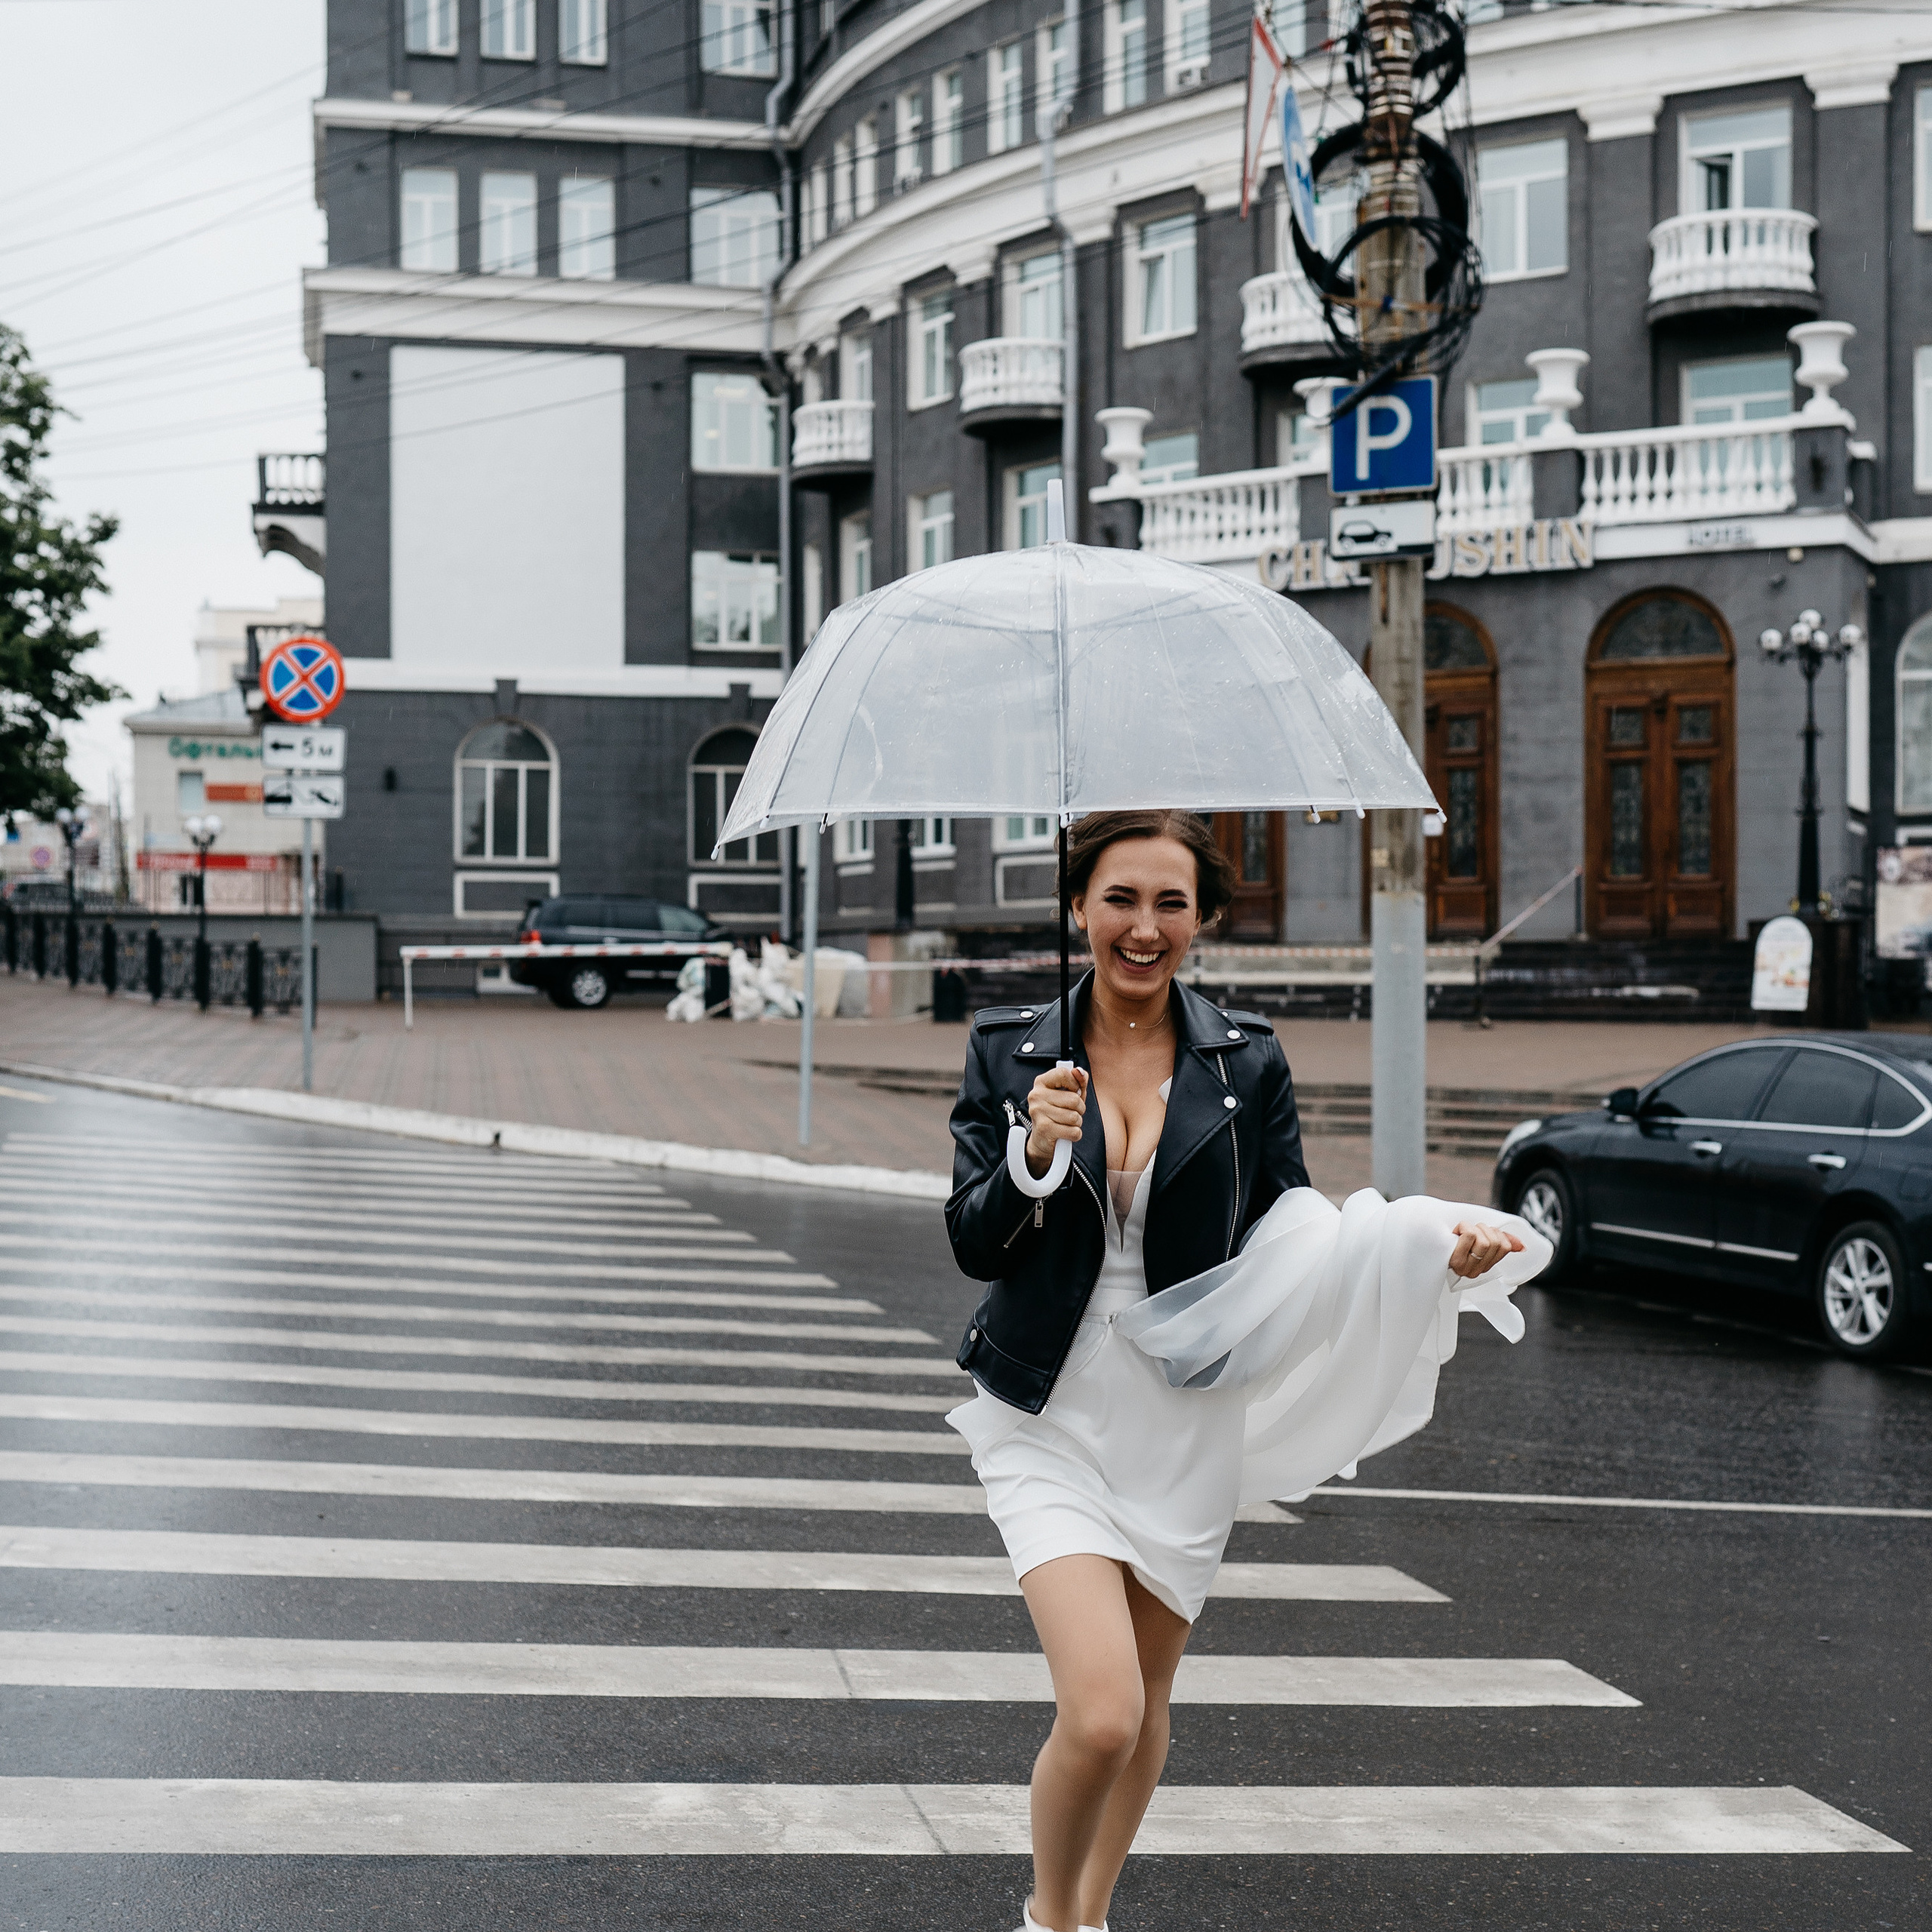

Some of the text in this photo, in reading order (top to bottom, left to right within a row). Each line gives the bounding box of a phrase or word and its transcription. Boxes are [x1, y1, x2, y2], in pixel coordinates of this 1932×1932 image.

[1355, 395, 1412, 481] P
[1258, 518, 1594, 592] CHUSHIN
[302, 737, 314, 757] 5
